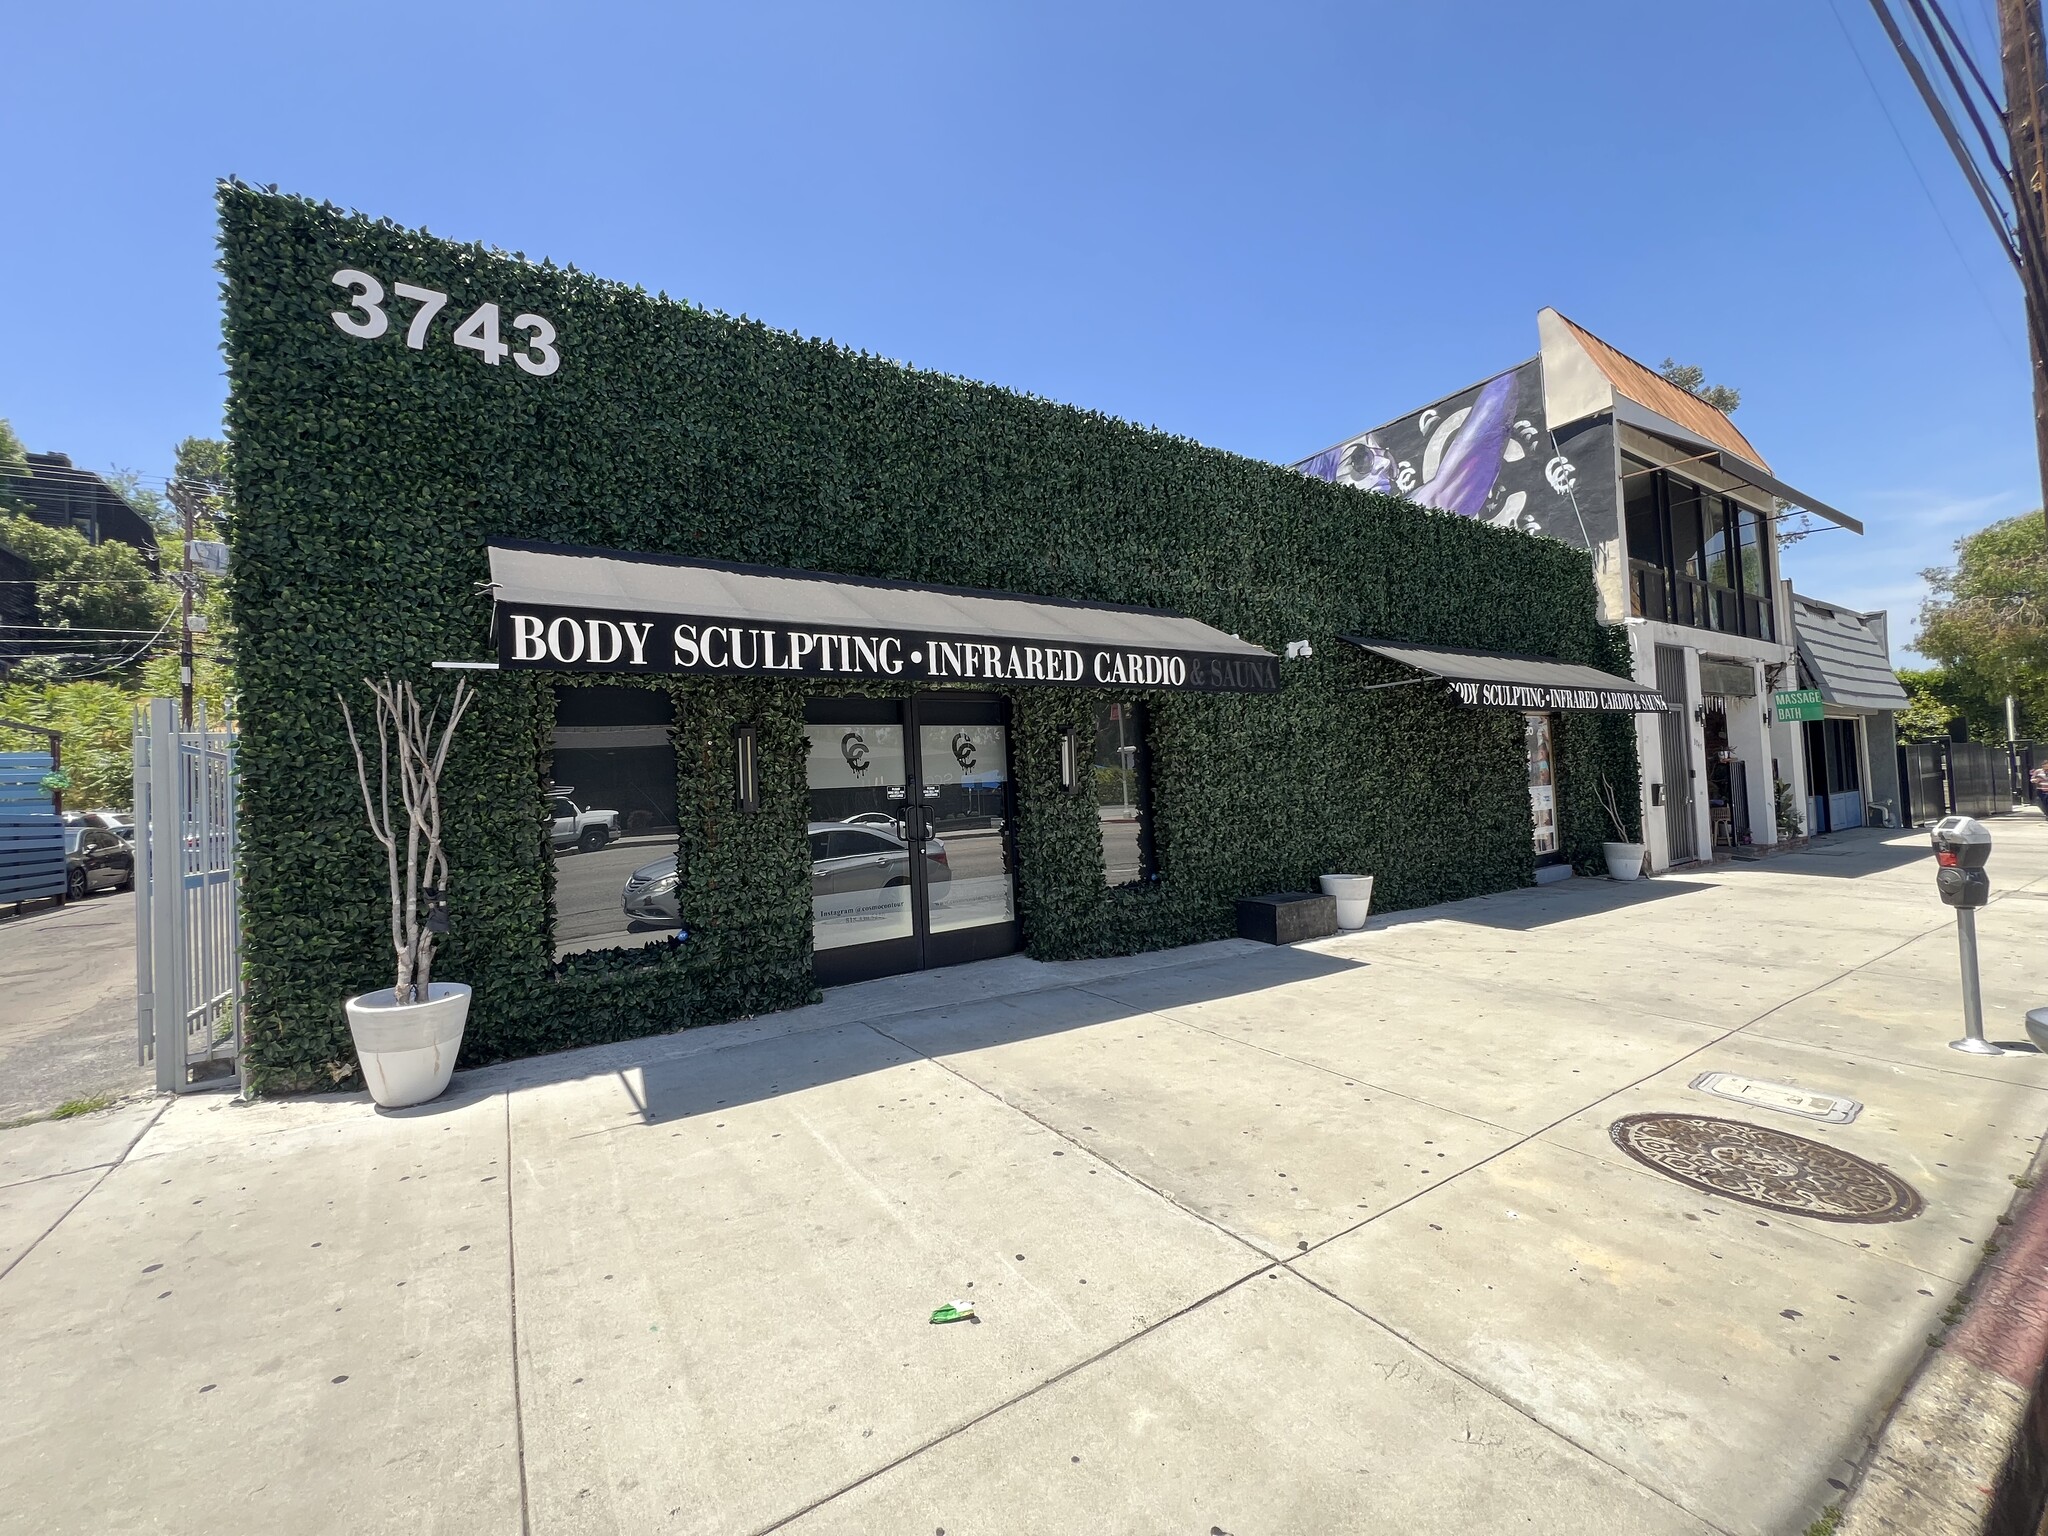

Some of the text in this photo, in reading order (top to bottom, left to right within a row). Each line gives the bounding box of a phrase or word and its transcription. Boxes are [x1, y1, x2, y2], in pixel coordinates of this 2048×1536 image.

[331, 269, 560, 377] 3743
[509, 614, 1277, 689] BODY SCULPTING INFRARED CARDIO & SAUNA
[1483, 684, 1545, 708] SCULPTING
[1549, 688, 1598, 709] INFRARED
[1600, 691, 1633, 710] CARDIO
[1775, 691, 1821, 705] MASSAGE
[1778, 707, 1802, 720] BATH
[820, 907, 854, 918] Instagram
